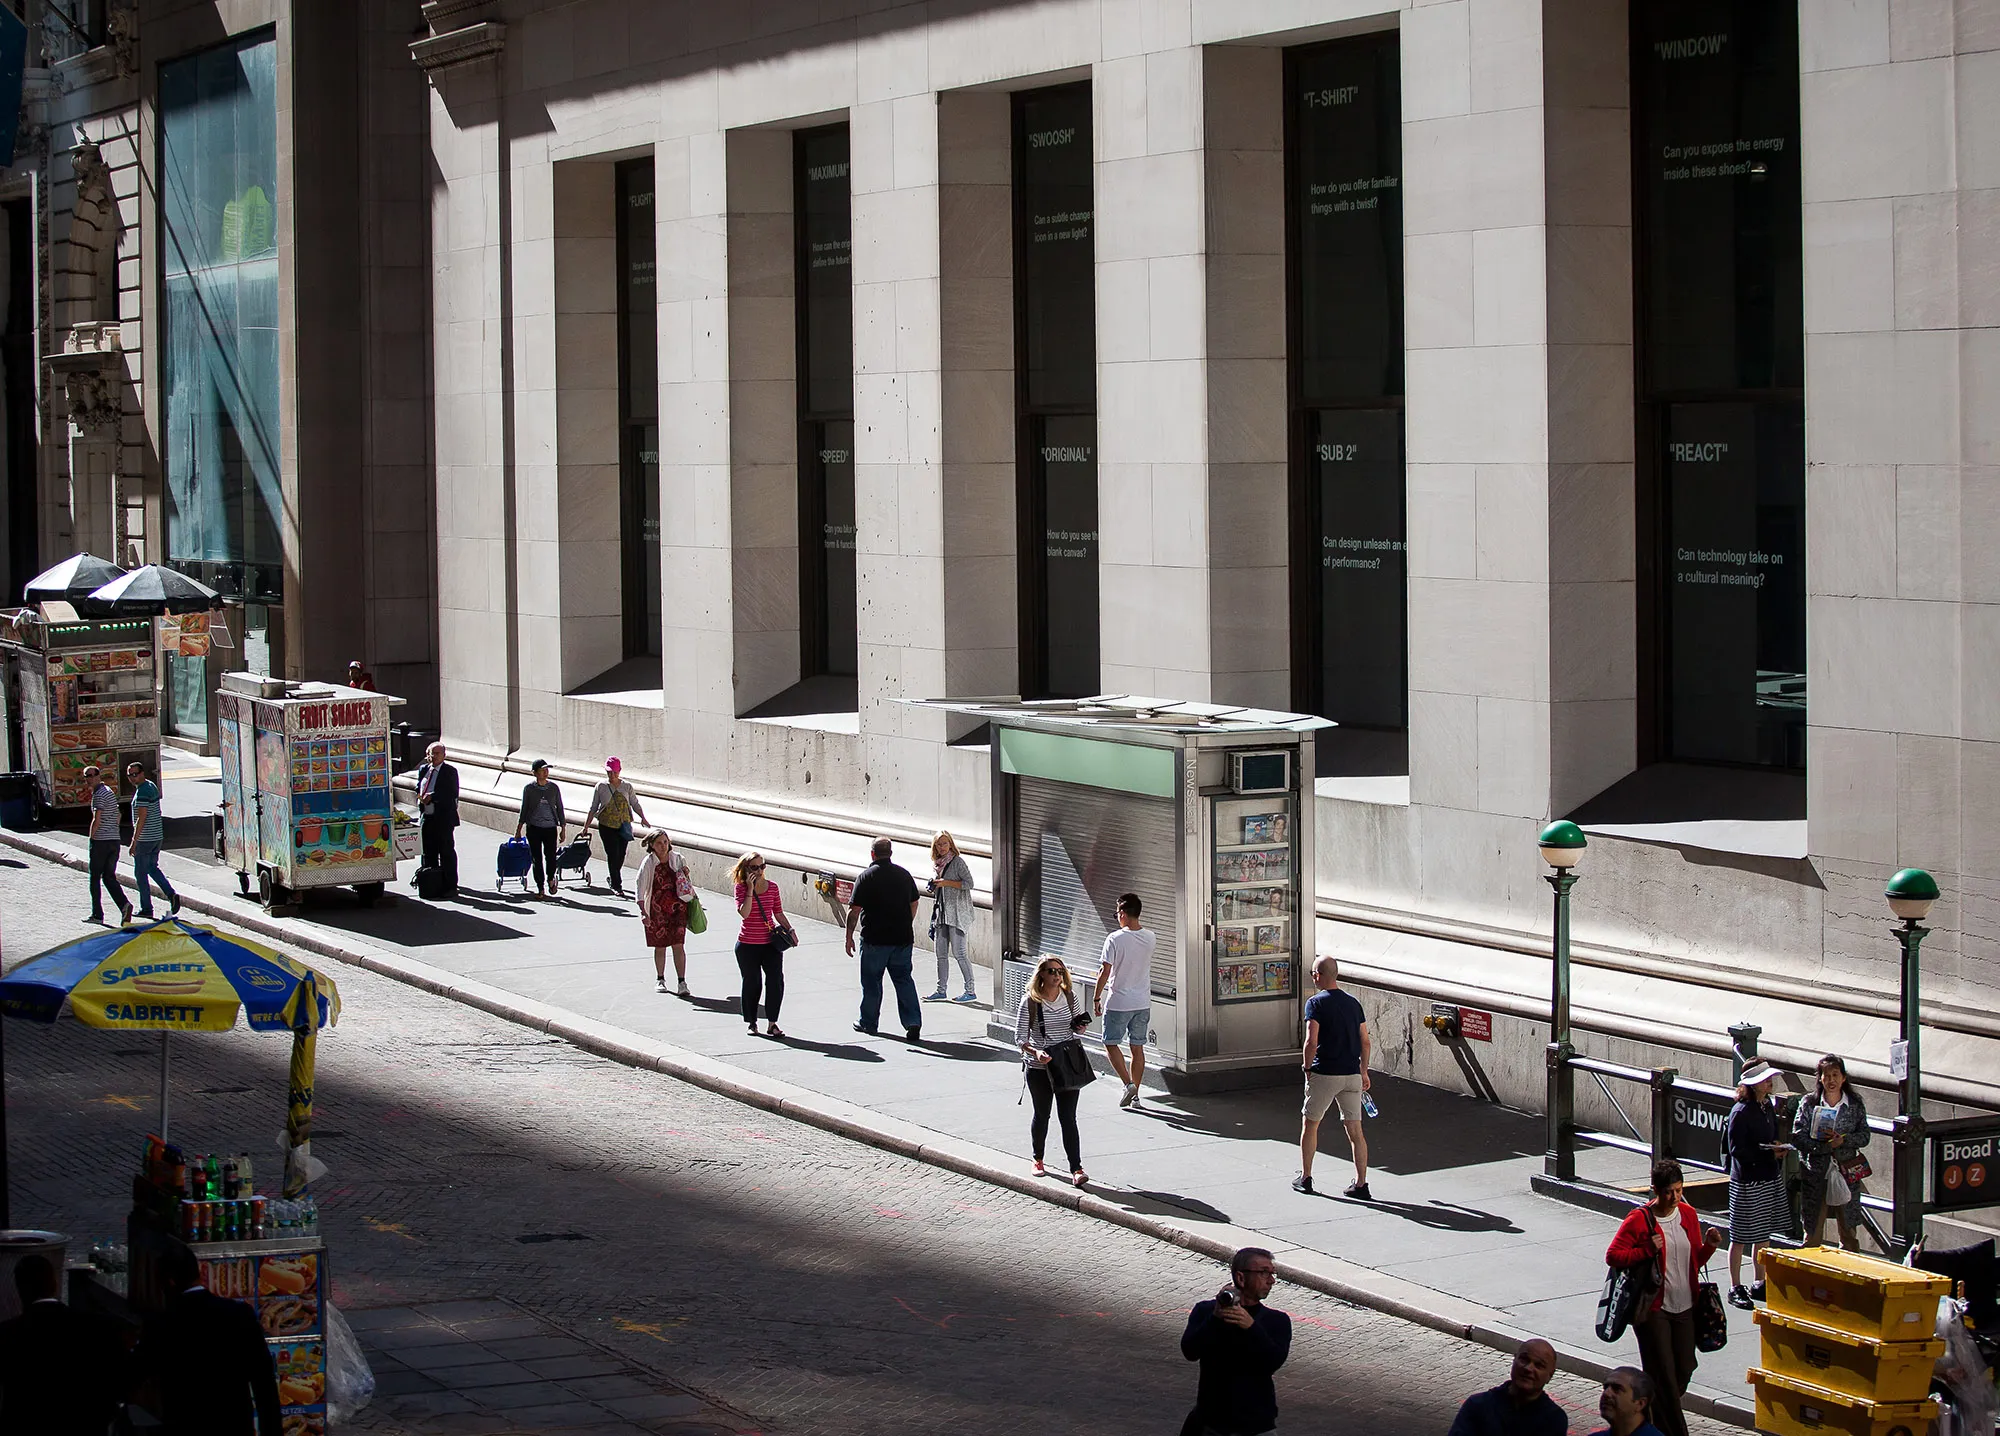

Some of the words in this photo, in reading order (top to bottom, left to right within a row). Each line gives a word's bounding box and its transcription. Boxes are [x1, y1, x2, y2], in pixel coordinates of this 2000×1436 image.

[1654, 34, 1728, 61] "WINDOW"
[1304, 86, 1358, 108] "T-SHIRT"
[1029, 128, 1076, 148] "SWOOSH"
[1663, 146, 1680, 159] Can
[1683, 146, 1699, 159] you
[1702, 141, 1734, 157] expose
[1736, 139, 1750, 151] the
[1753, 137, 1784, 151] energy
[809, 163, 849, 181] "MAXIMUM"
[1664, 167, 1690, 180] inside
[1692, 164, 1716, 178] these
[1719, 160, 1751, 176] shoes?
[1311, 184, 1326, 195] How
[1328, 182, 1337, 193] do
[1339, 182, 1351, 194] you
[1353, 179, 1369, 191] offer
[1371, 176, 1398, 188] familiar
[1311, 203, 1332, 215] things
[1334, 200, 1349, 212] with
[1350, 202, 1355, 210] a
[1357, 197, 1378, 210] twist?
[1034, 215, 1046, 225] Can
[1052, 212, 1068, 223] subtle
[1070, 211, 1090, 222] change
[1035, 233, 1046, 242] icon
[1048, 231, 1054, 240] in
[1071, 227, 1088, 240] light?
[813, 243, 823, 252] How
[824, 243, 832, 251] can
[819, 450, 849, 464] "SPEED"
[1041, 447, 1091, 462] "ORIGINAL"
[1316, 444, 1343, 461] "SUB
[1346, 444, 1357, 461] 2"
[1670, 443, 1728, 462] "REACT"
[824, 524, 833, 533] Can
[834, 526, 842, 535] you
[1047, 529, 1059, 539] How
[1061, 530, 1068, 540] do
[1070, 531, 1080, 541] you
[1047, 547, 1063, 557] blank
[1064, 548, 1087, 558] canvas?
[1323, 536, 1337, 548] Can
[1339, 537, 1362, 551] design
[1363, 538, 1391, 550] unleash
[1392, 541, 1401, 551] an
[1323, 556, 1330, 567] of
[1332, 557, 1380, 569] performance?
[1678, 548, 1695, 560] Can
[1697, 549, 1747, 566] technology
[1750, 551, 1768, 564] take
[1771, 554, 1783, 564] on
[1678, 573, 1683, 582] a
[1686, 571, 1718, 584] cultural
[1721, 572, 1765, 589] meaning?
[299, 704, 329, 729] FRUIT
[331, 702, 371, 727] SHAKES
[100, 963, 206, 985] SABRETT
[106, 1003, 205, 1022] SABRETT
[1943, 1139, 1991, 1161] Broad
[1948, 1170, 1957, 1184] J
[1970, 1168, 1981, 1182] Z
